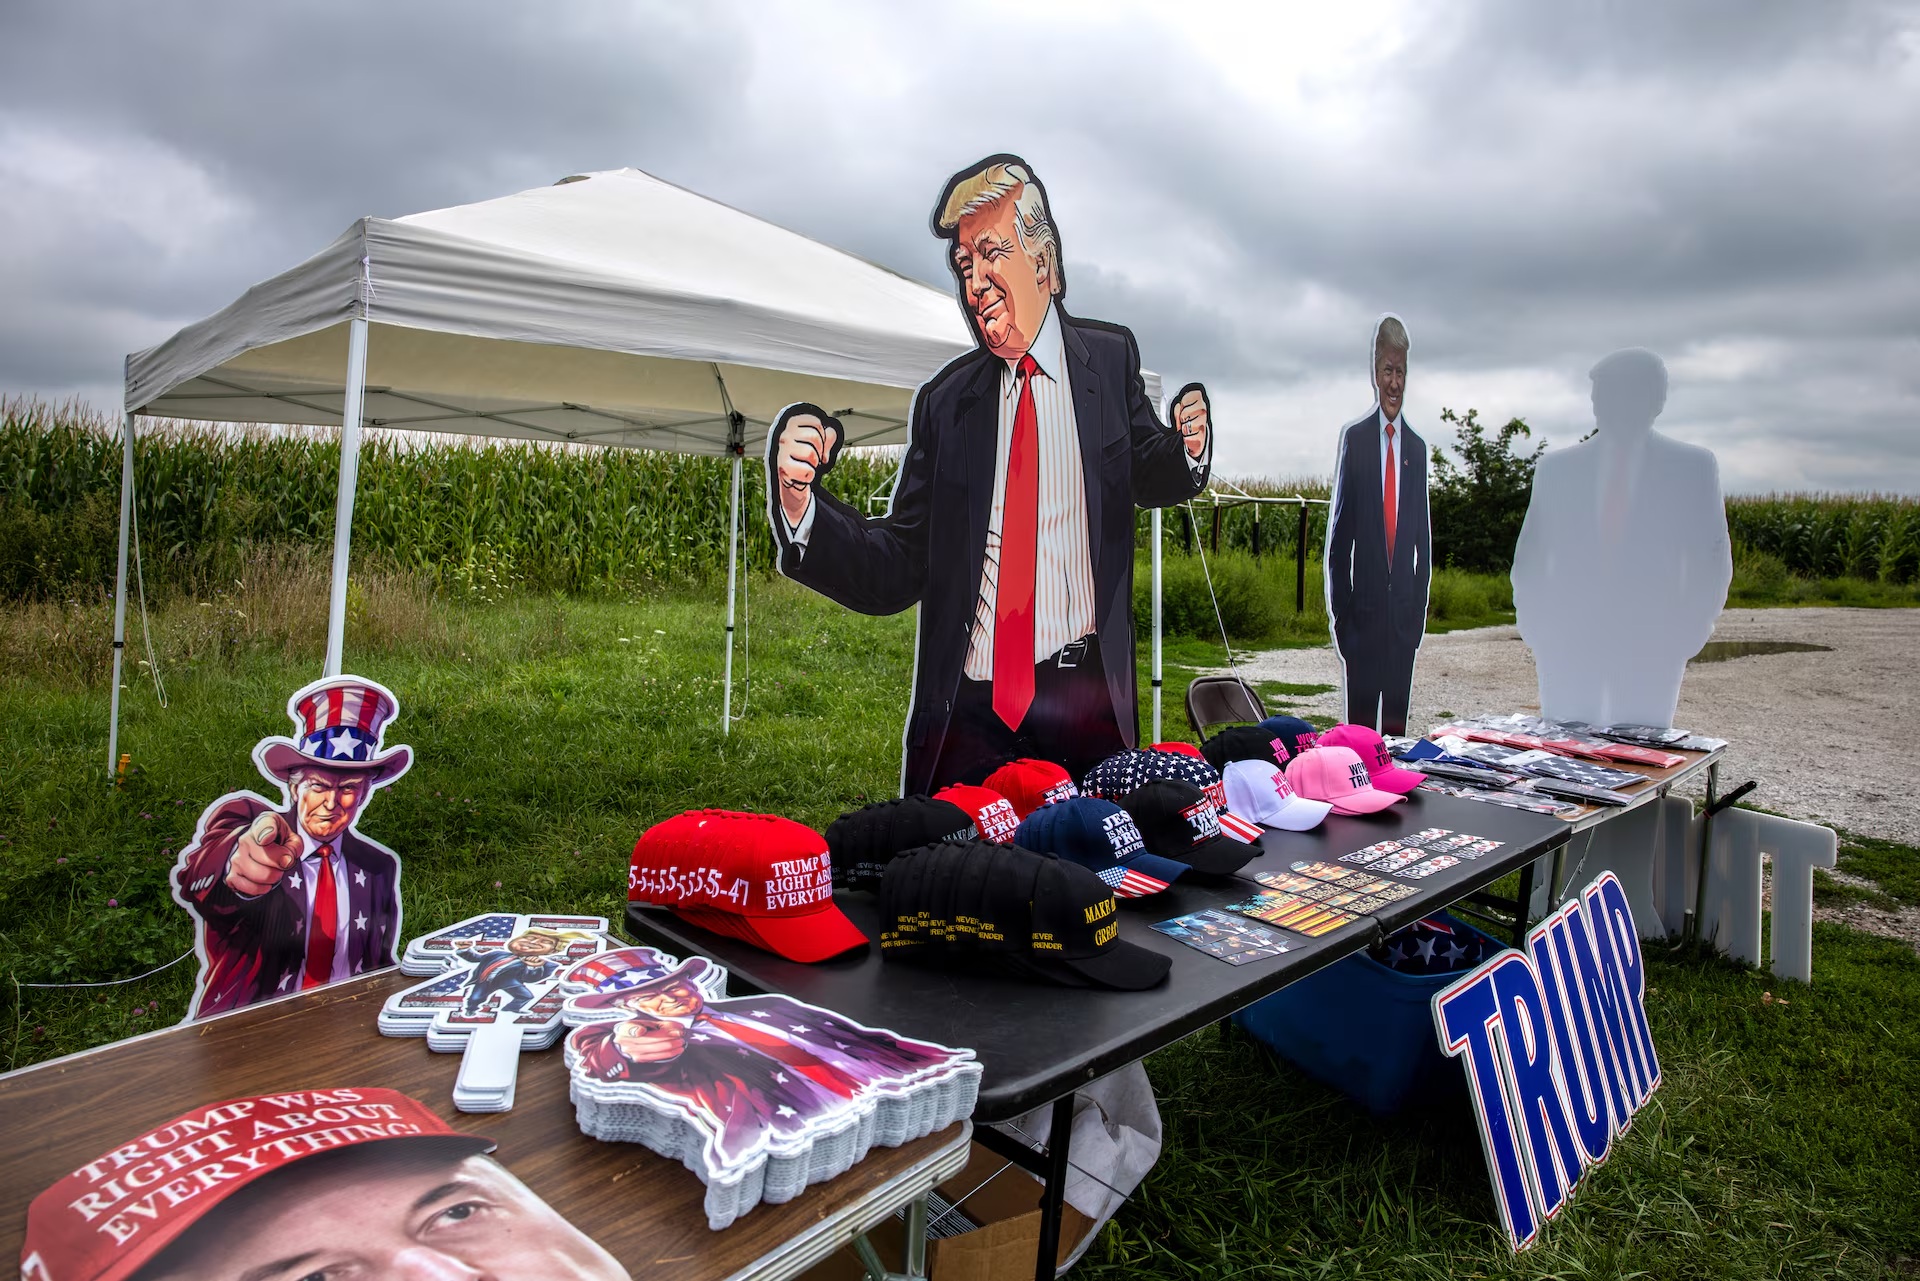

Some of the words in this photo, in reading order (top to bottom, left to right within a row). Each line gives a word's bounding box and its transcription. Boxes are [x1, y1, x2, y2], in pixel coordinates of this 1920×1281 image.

[1102, 809, 1133, 831] JES
[771, 856, 819, 878] TRUMP
[765, 873, 813, 895] RIGHT
[1083, 898, 1111, 924] MAKE
[1032, 941, 1063, 951] RENDER
[1437, 873, 1661, 1251] TRUMP
[73, 1101, 255, 1184] TRUMP
[260, 1089, 364, 1109] WAS
[67, 1129, 238, 1223] RIGHT
[252, 1103, 403, 1141] ABOUT
